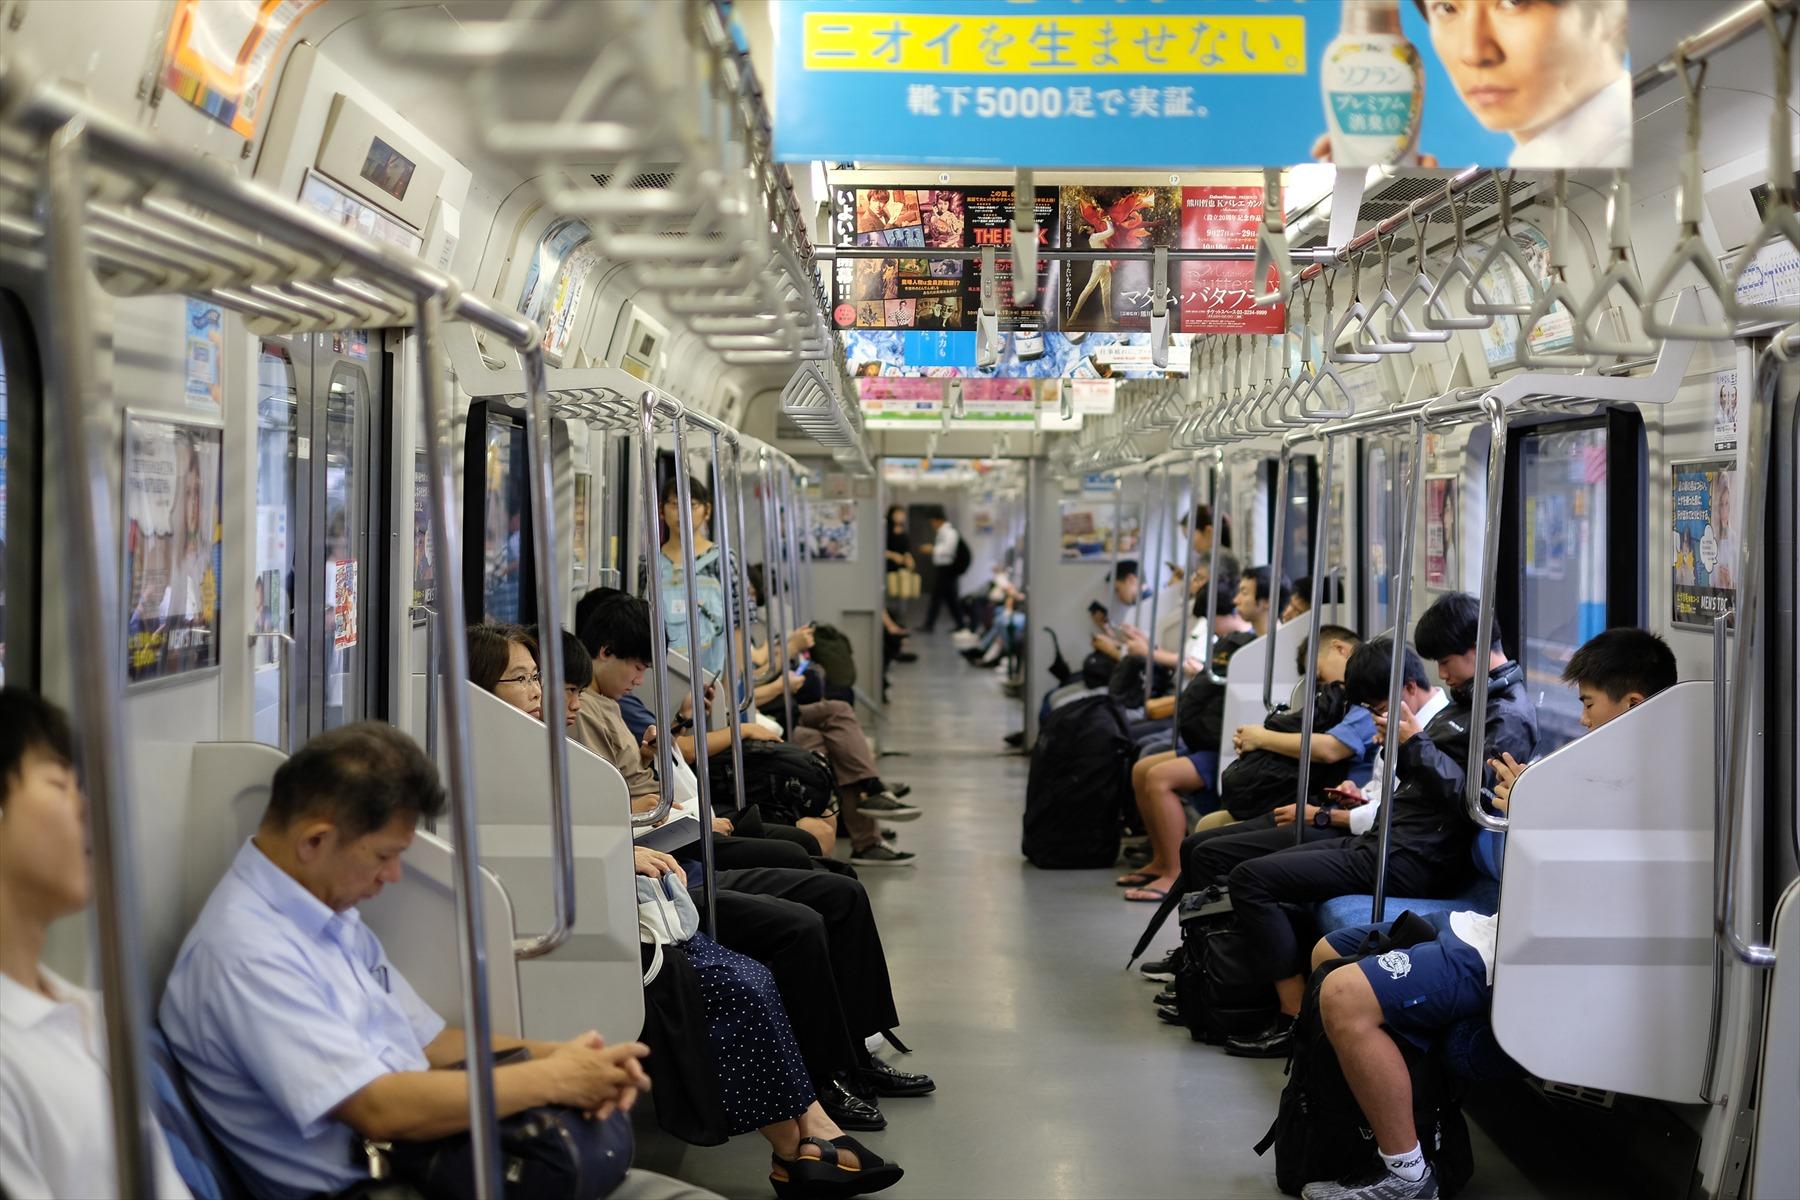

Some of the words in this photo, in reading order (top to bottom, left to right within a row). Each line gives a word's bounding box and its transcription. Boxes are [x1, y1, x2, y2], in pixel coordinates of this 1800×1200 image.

[813, 21, 1299, 69] ニオイを生ませない。
[908, 84, 1209, 118] 靴下5000足で実証。
[1336, 95, 1406, 111] プレミアム
[973, 228, 1001, 244] THE
[1003, 228, 1049, 245] BK
[1700, 595, 1717, 610] MEN'S
[1717, 597, 1729, 612] TBC
[1403, 1154, 1422, 1168] asic
